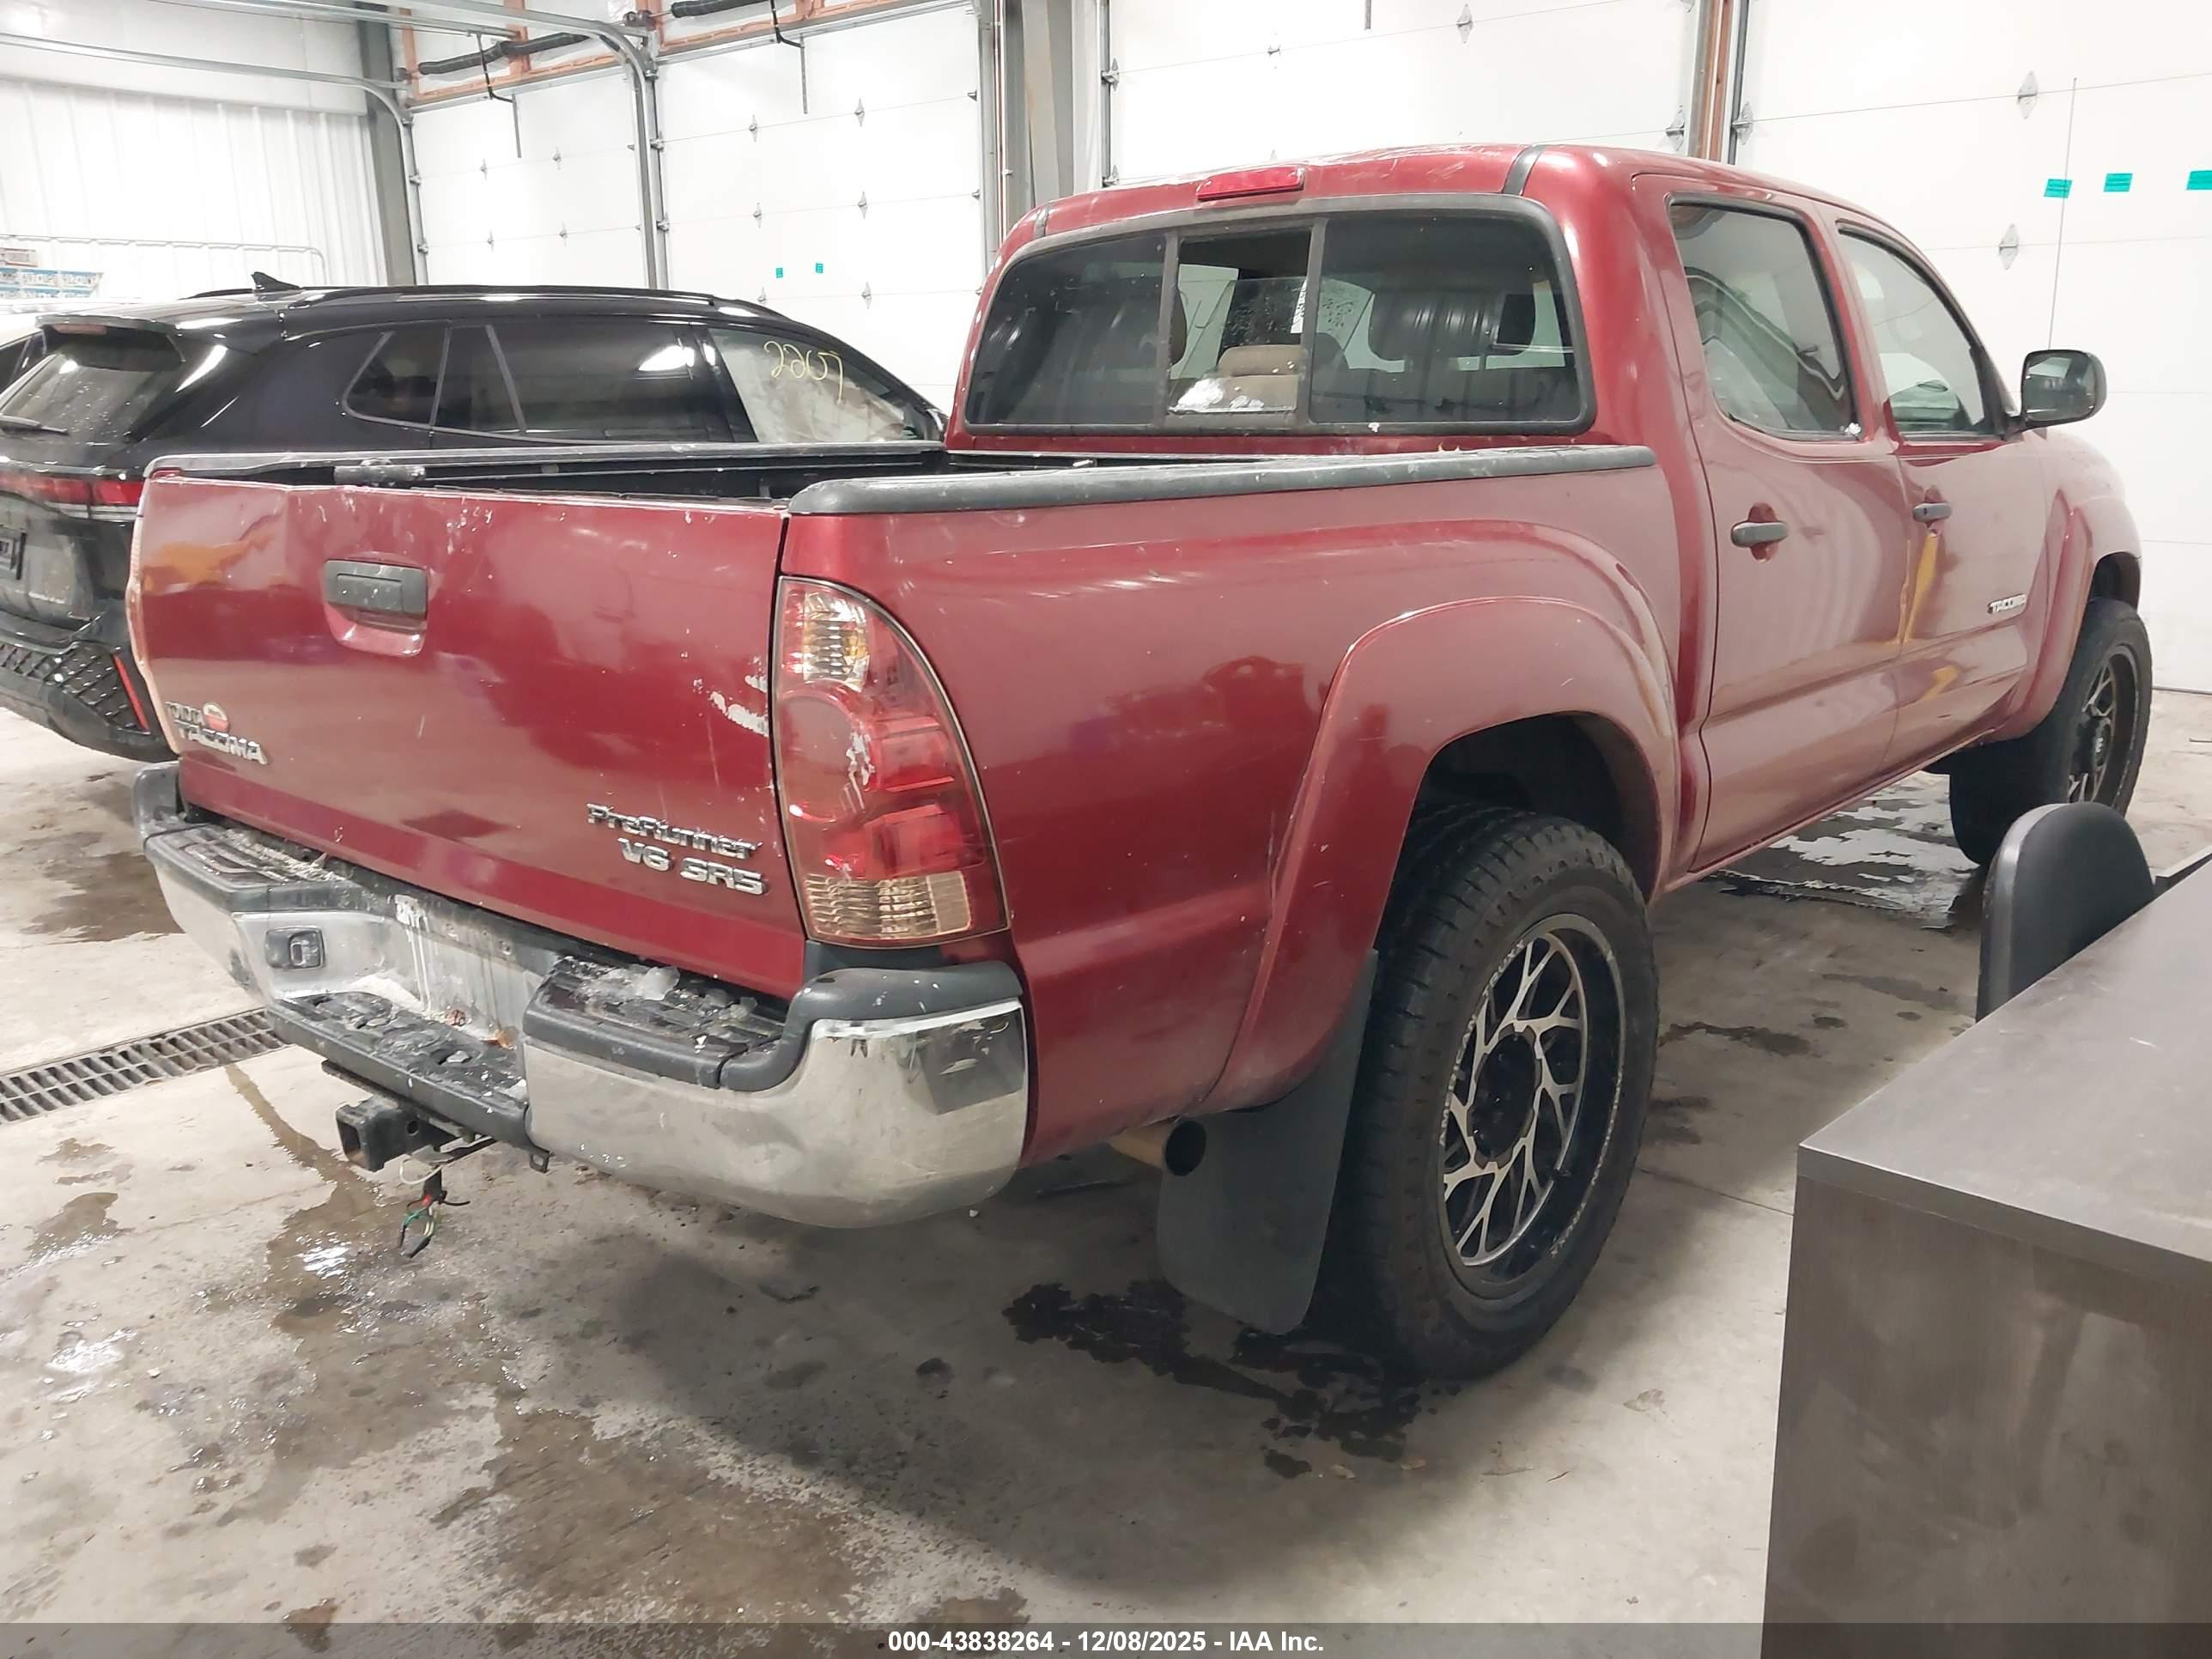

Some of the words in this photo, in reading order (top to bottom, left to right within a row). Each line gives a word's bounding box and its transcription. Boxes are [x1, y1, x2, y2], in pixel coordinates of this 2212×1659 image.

[174, 720, 268, 765] TACOMA
[586, 803, 763, 859] PreRunner
[617, 837, 671, 872] V6
[679, 857, 764, 895] SR5
